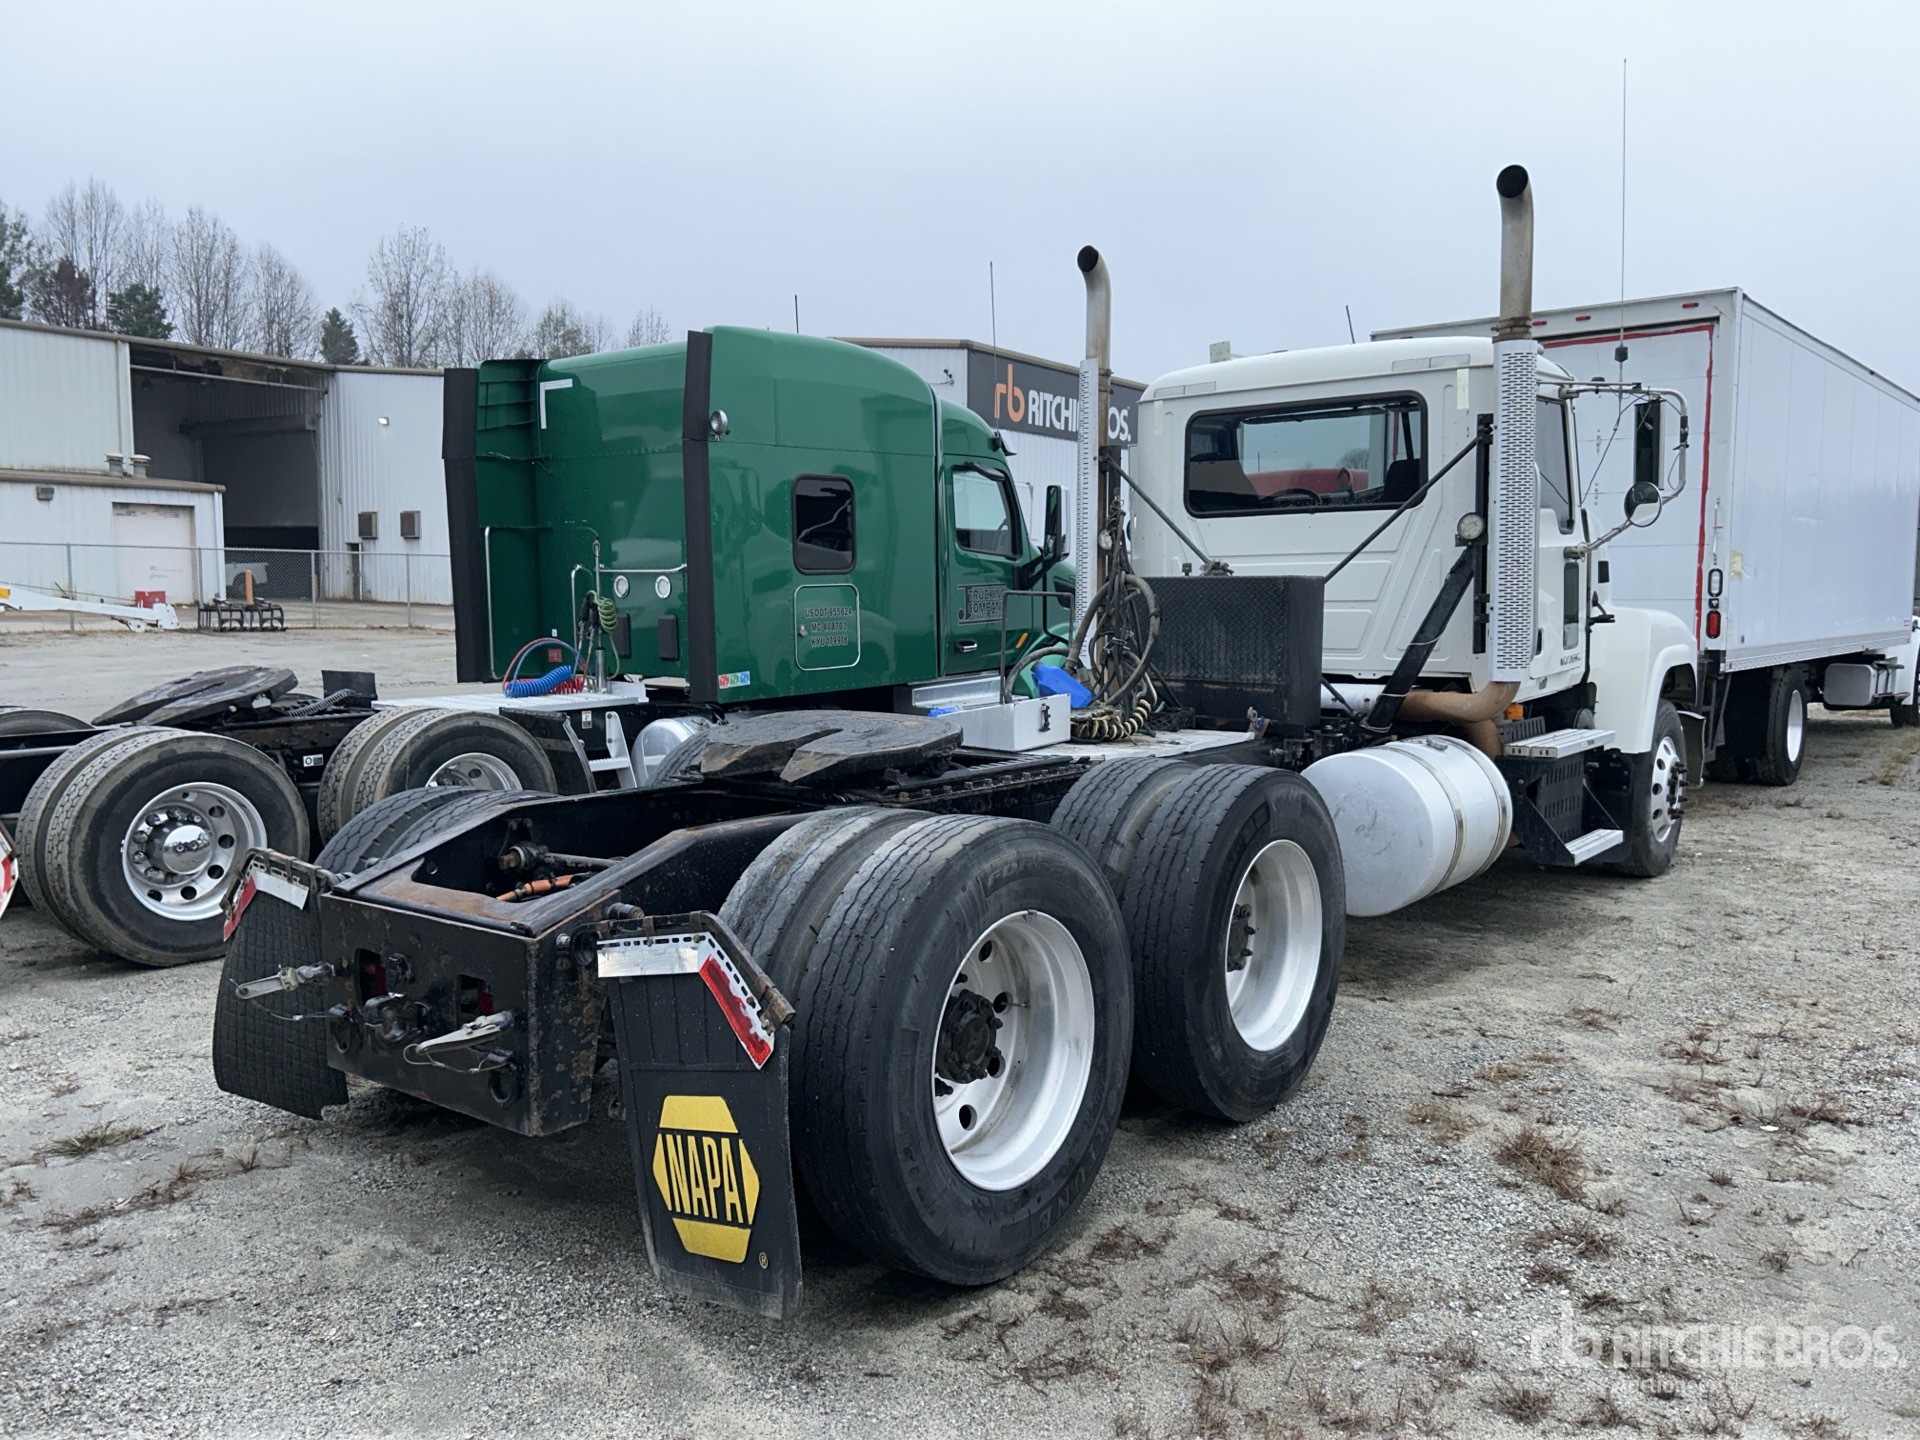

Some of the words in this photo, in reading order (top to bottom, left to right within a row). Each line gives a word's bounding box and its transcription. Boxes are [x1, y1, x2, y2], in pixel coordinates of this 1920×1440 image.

[1028, 389, 1079, 432] RITCHI
[1108, 406, 1132, 442] OS.
[829, 607, 852, 617] 955624
[969, 602, 1003, 613] COMPAN
[811, 623, 822, 632] MC
[666, 1134, 744, 1224] NAPA
